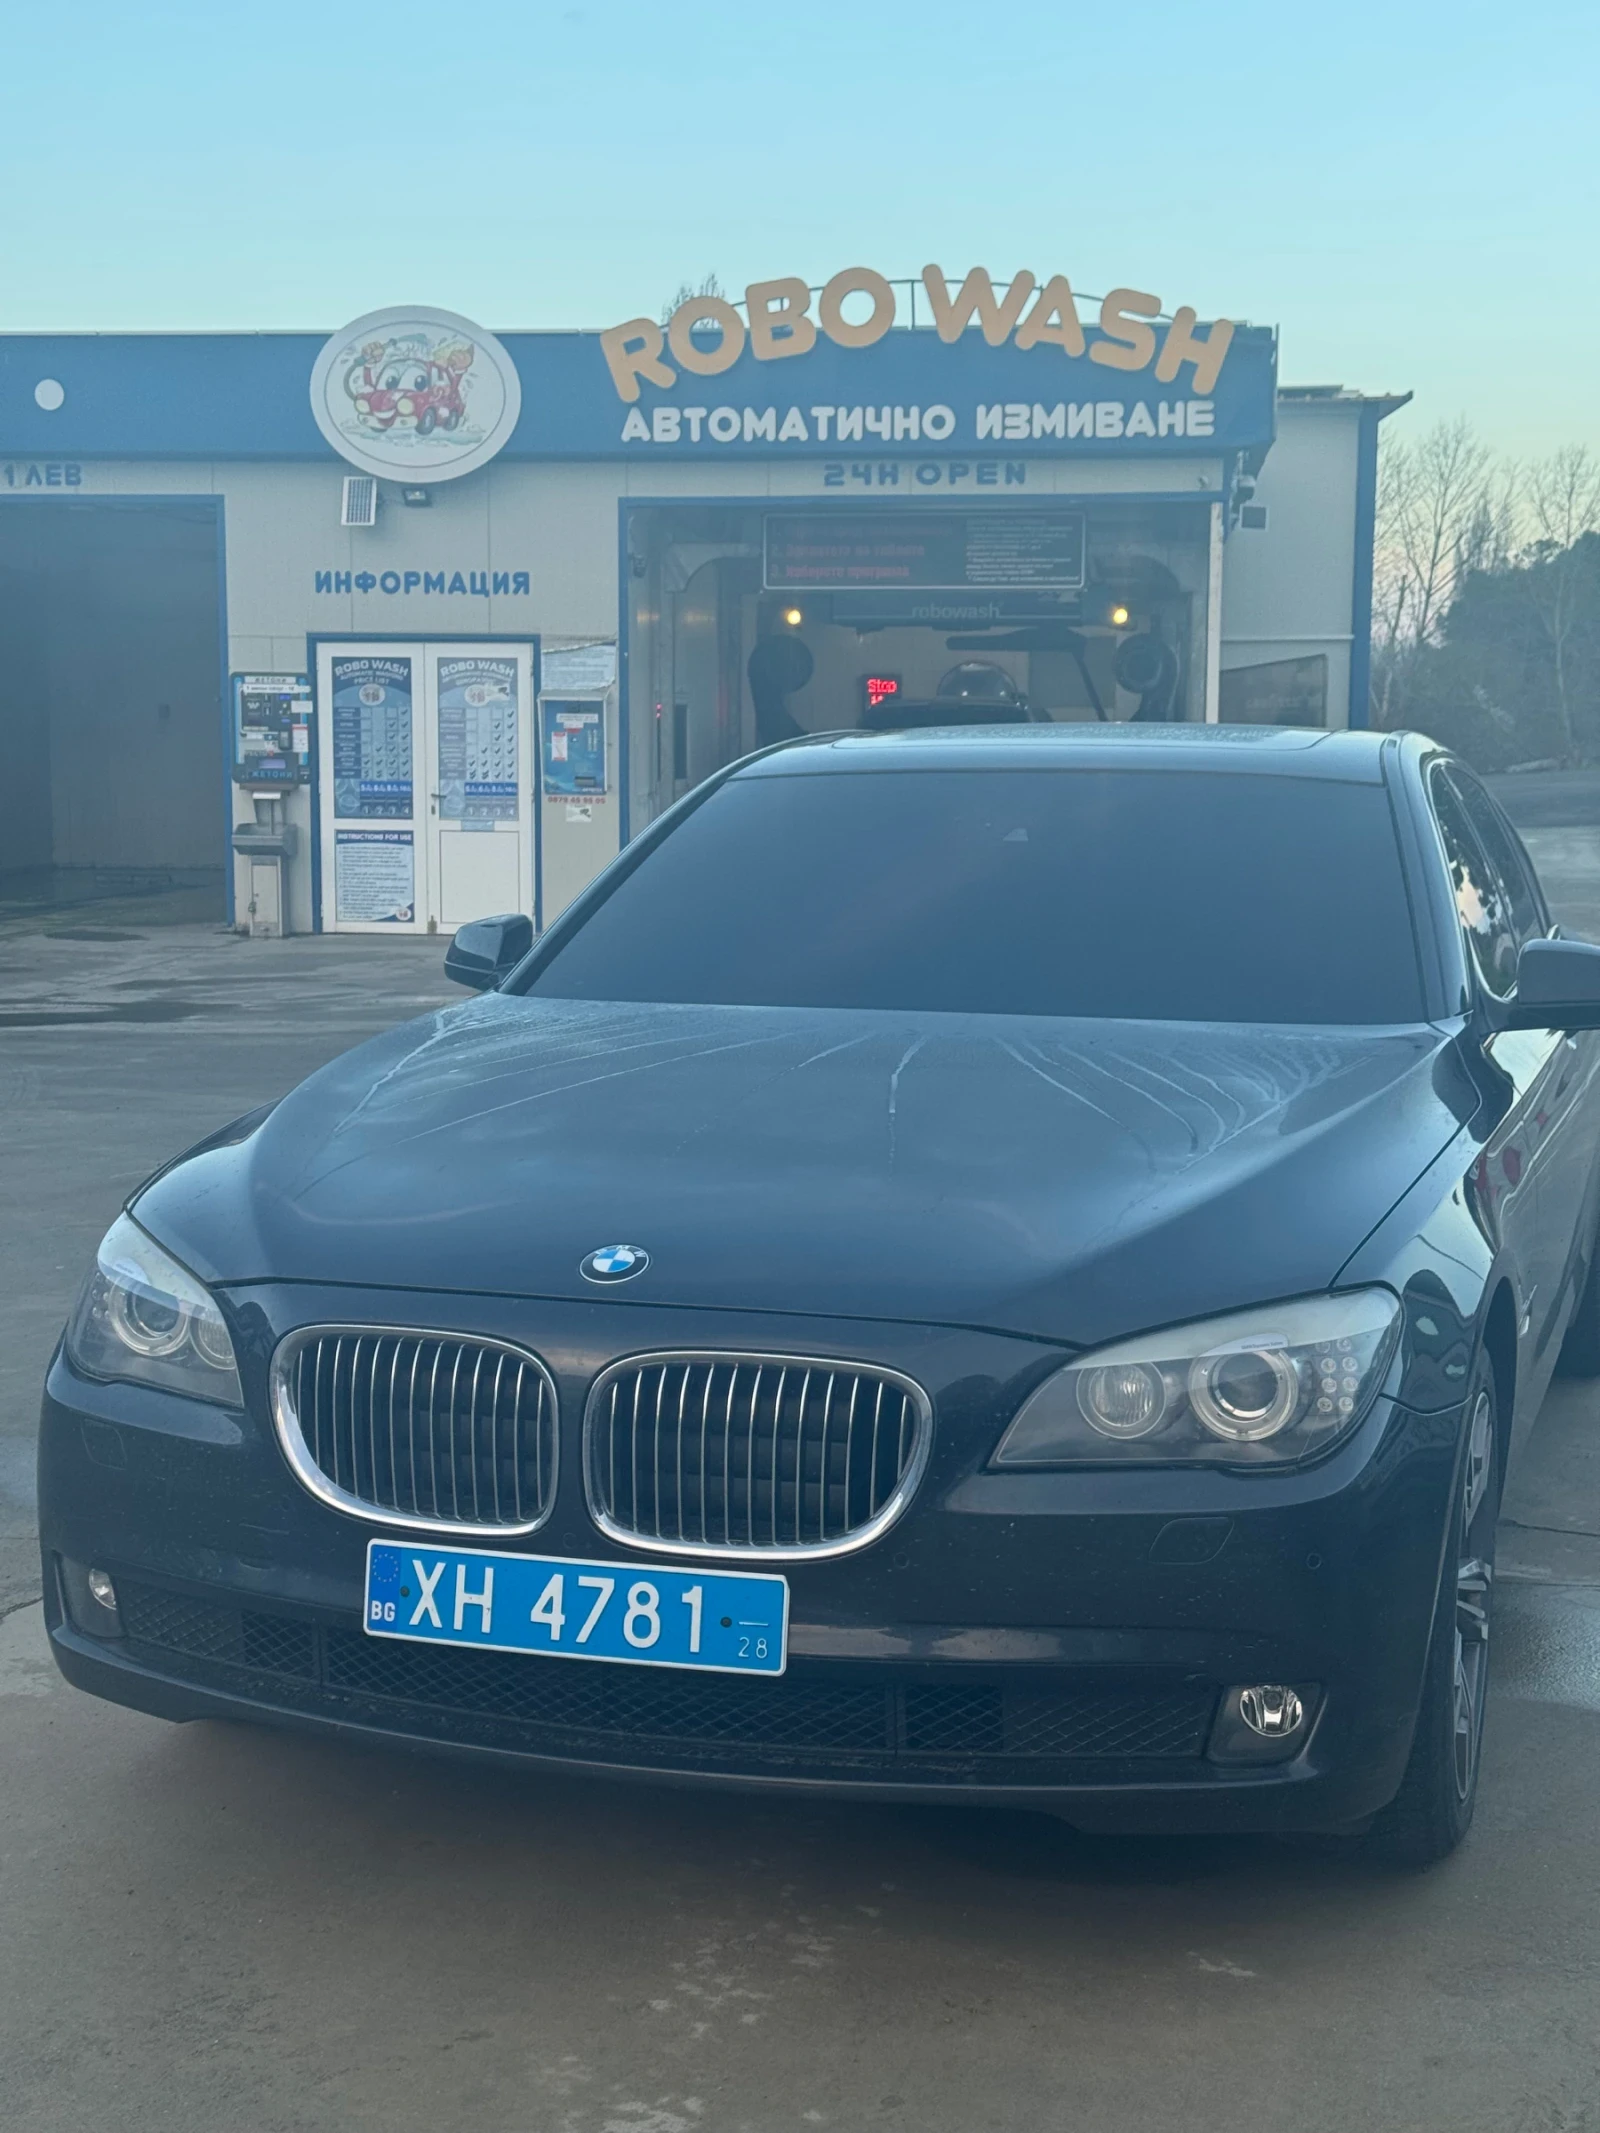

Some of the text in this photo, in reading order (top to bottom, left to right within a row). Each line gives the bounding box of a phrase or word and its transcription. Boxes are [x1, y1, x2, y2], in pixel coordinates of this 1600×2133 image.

[600, 264, 1234, 403] ROBO WASH
[621, 401, 1215, 443] АВТОМАТИЧНО ИЗМИВАНЕ
[4, 463, 82, 487] 1 ЛЕВ
[823, 463, 1026, 486] 24H OPEN
[315, 571, 530, 598] ИНФОРМАЦИЯ
[912, 601, 1000, 619] robowash
[335, 659, 409, 677] ROBO WASH
[440, 660, 475, 677] ROBO
[477, 660, 515, 677] WASH
[867, 678, 898, 694] Stop
[385, 833, 399, 841] FOR
[371, 1600, 396, 1622] BG
[408, 1559, 703, 1653] XH 4781
[737, 1636, 768, 1660] 28
